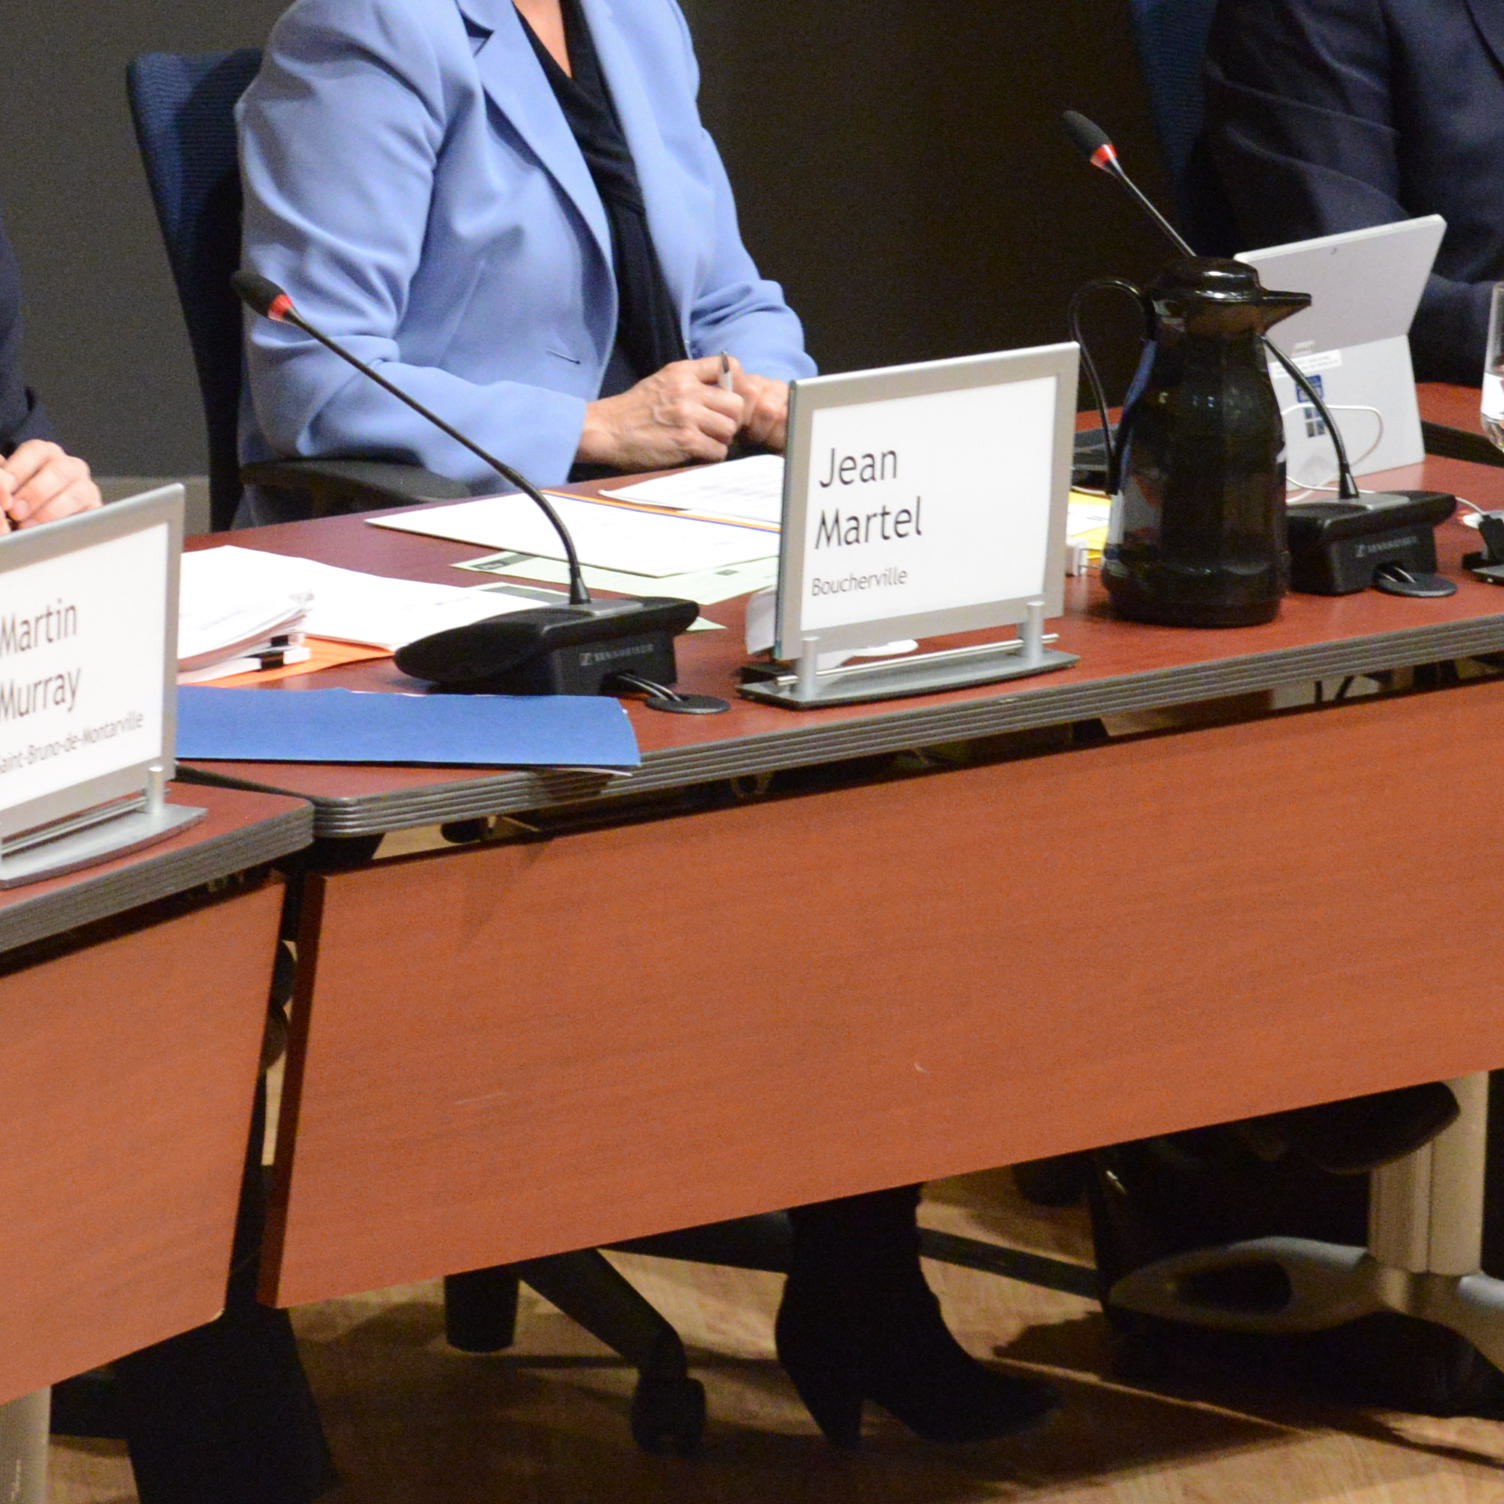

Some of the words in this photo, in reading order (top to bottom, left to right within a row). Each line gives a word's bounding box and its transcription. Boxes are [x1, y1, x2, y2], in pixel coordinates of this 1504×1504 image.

[819, 447, 898, 489] Jean
[815, 496, 922, 550] Martel
[811, 566, 908, 597] Boucherville
